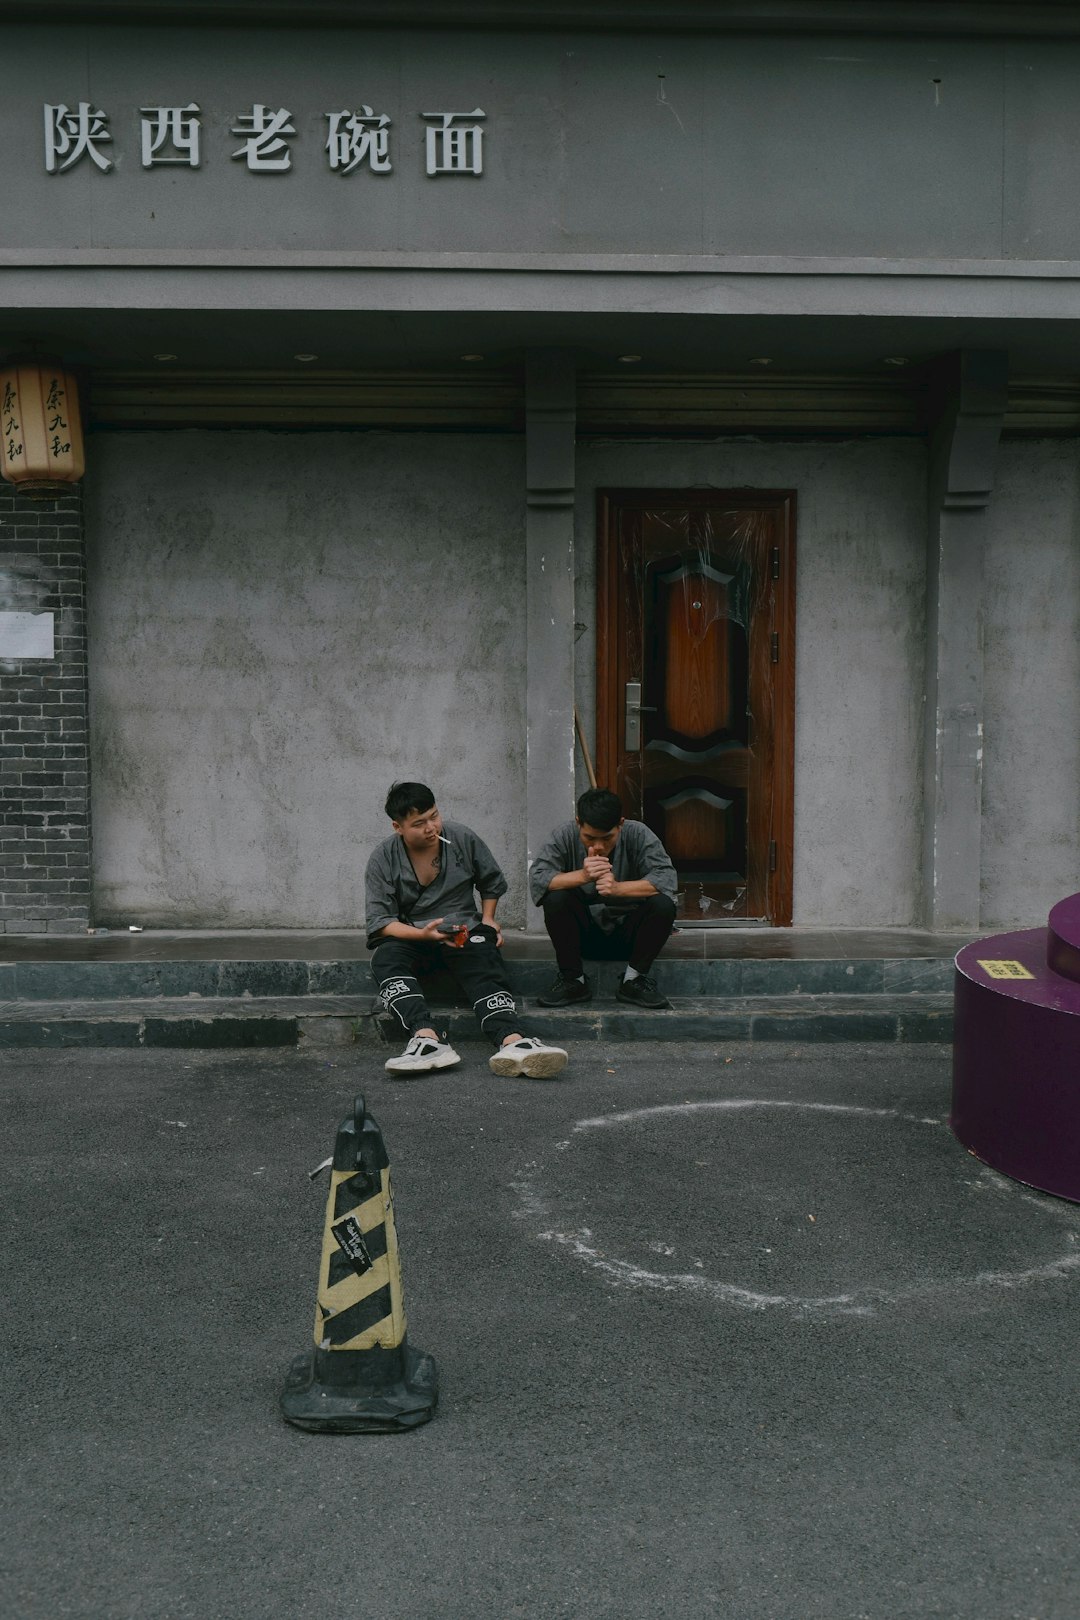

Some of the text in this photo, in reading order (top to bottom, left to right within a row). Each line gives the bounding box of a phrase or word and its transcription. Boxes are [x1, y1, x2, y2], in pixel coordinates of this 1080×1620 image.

[43, 101, 487, 177] 陕西老碗面
